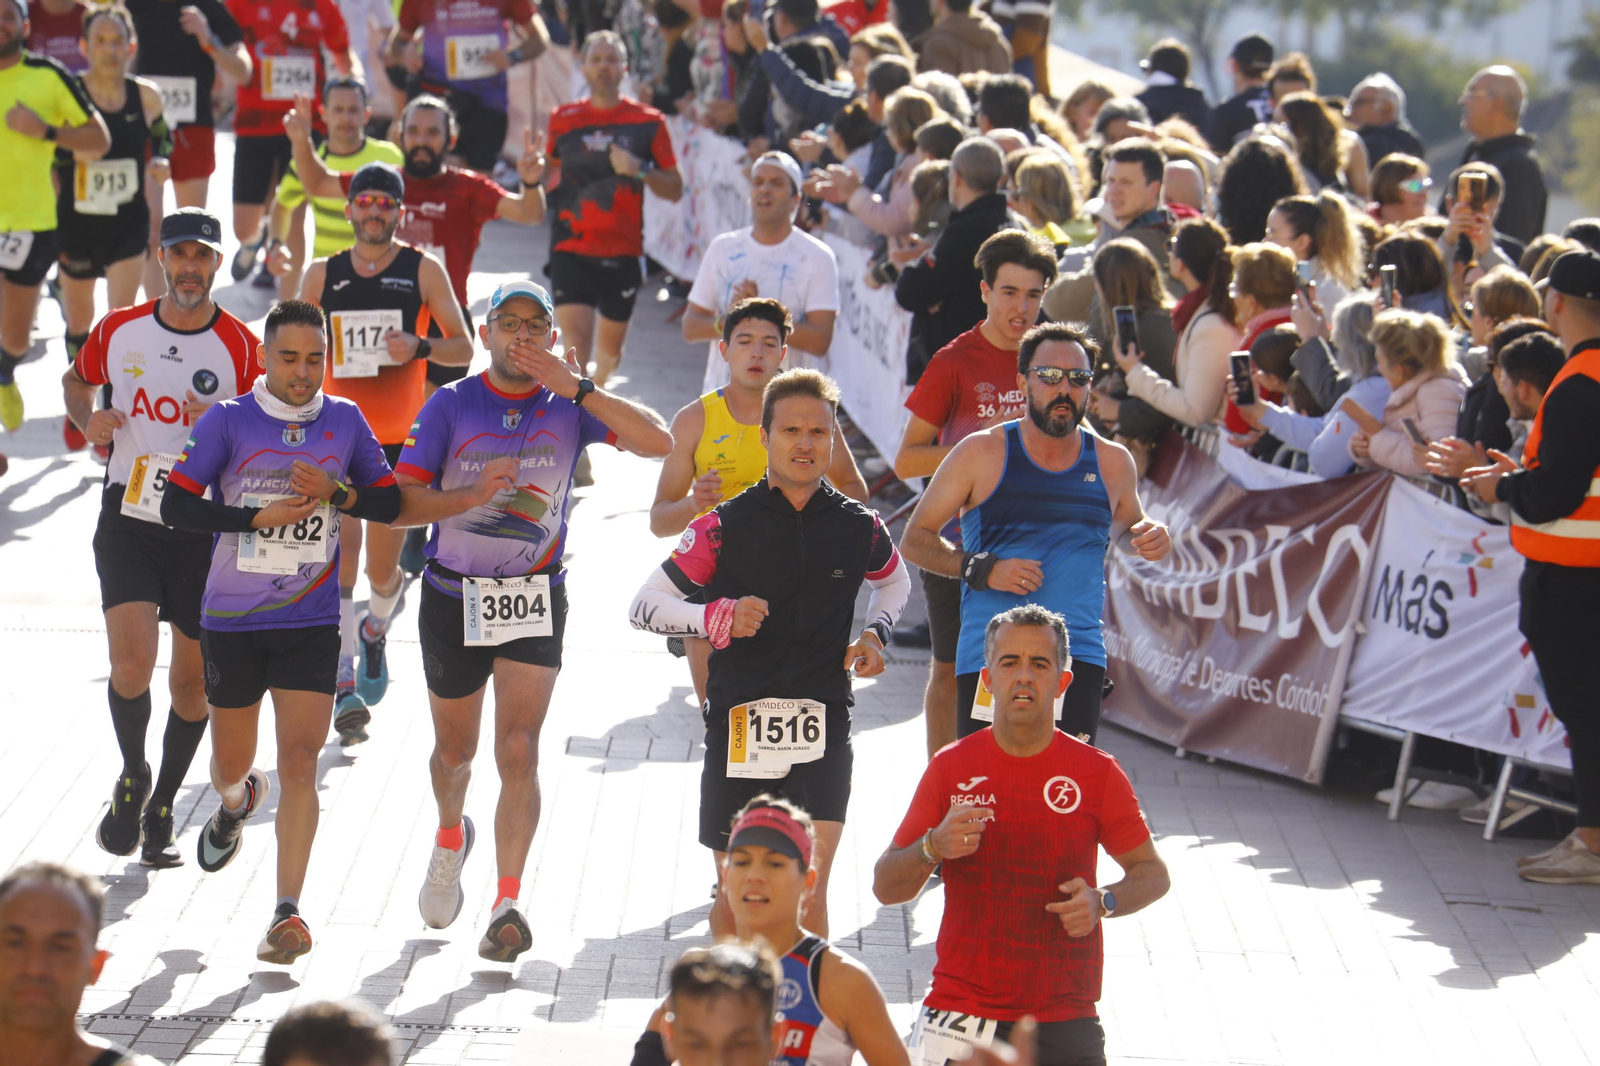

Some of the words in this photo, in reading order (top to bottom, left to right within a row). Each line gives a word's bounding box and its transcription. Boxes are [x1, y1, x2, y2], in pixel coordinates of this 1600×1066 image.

[94, 172, 127, 191] 913
[344, 325, 394, 348] 117
[159, 353, 184, 364] VIATOR
[977, 403, 996, 418] 36
[482, 593, 546, 621] 3804
[1372, 550, 1453, 639] Más
[1199, 655, 1273, 705] Deportes
[758, 701, 795, 710] IMDECO
[735, 721, 743, 749] CAJÓN
[750, 715, 820, 744] 1516
[950, 794, 996, 806] REGALA
[924, 1007, 988, 1039] 4721
